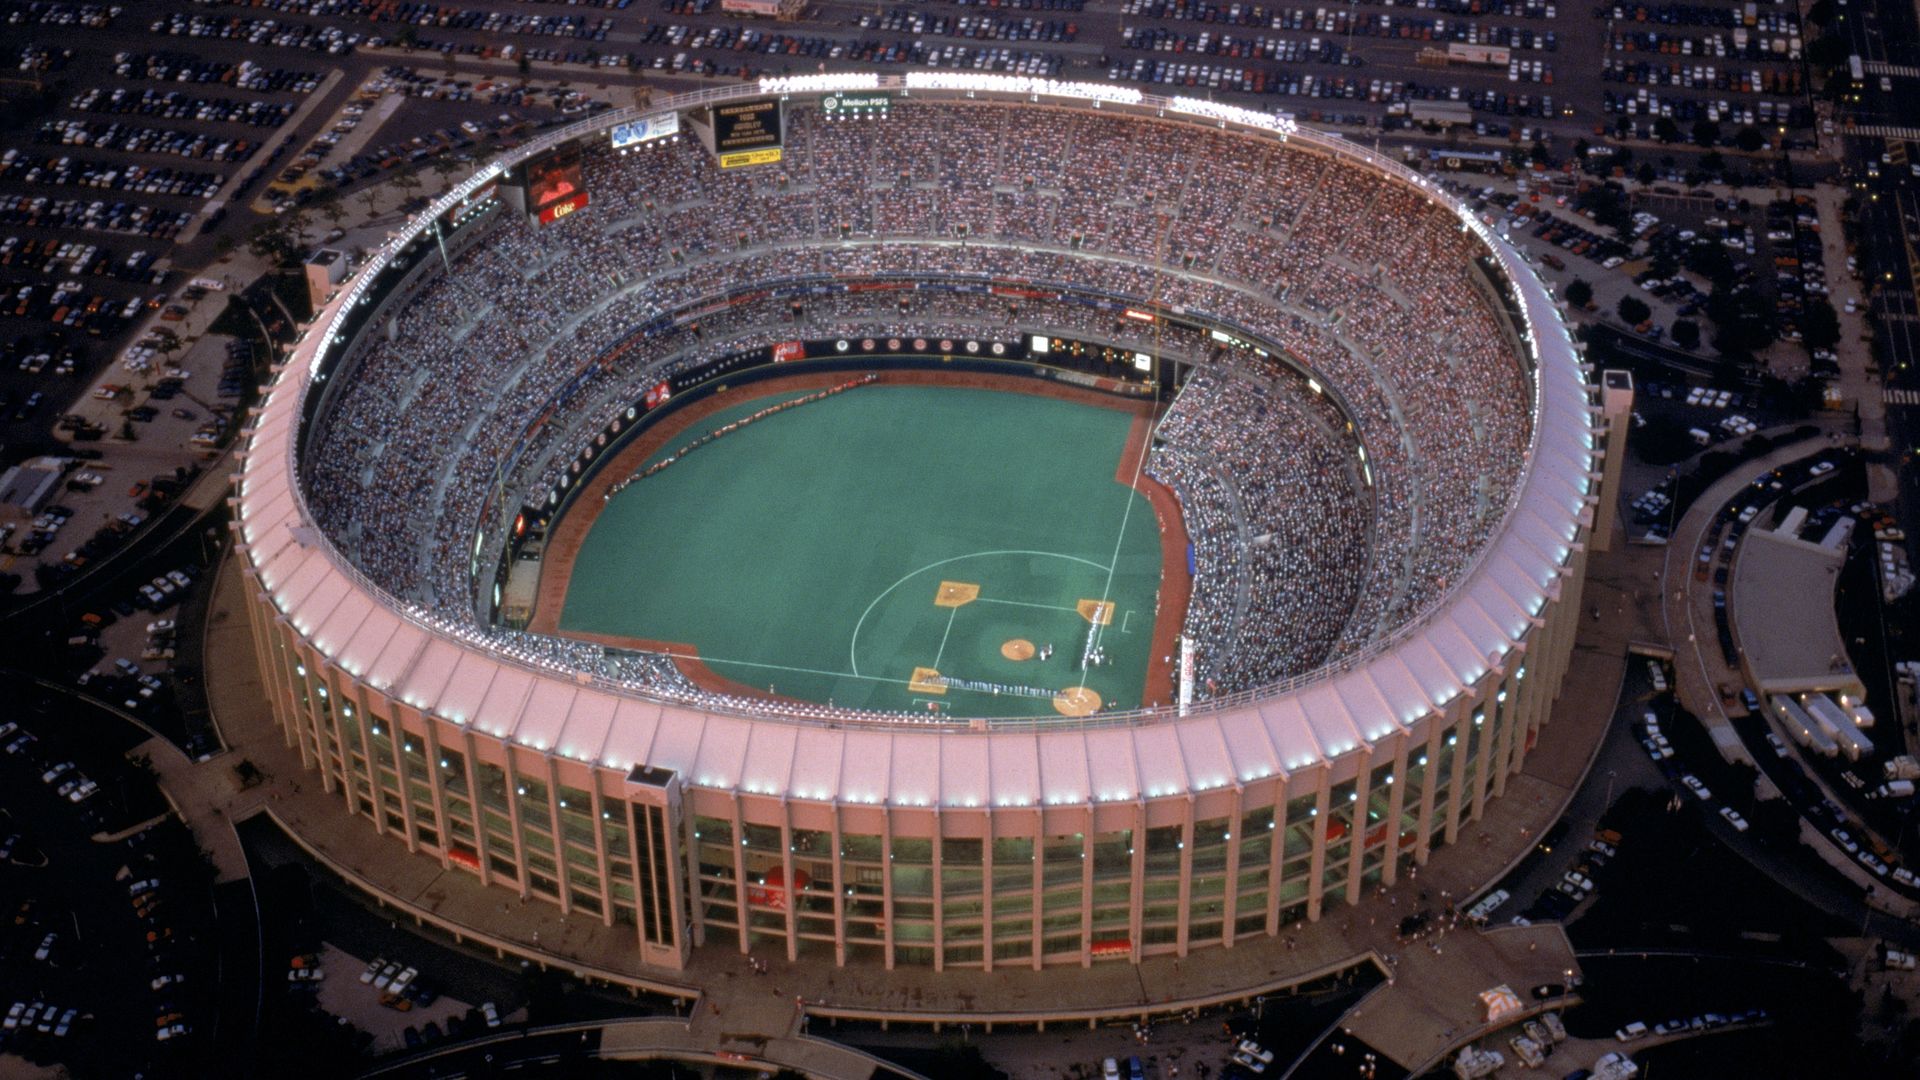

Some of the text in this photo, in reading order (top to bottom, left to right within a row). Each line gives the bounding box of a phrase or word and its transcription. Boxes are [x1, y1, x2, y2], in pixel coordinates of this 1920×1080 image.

[842, 97, 889, 106] Mellon PSFS
[554, 202, 575, 218] Coke
